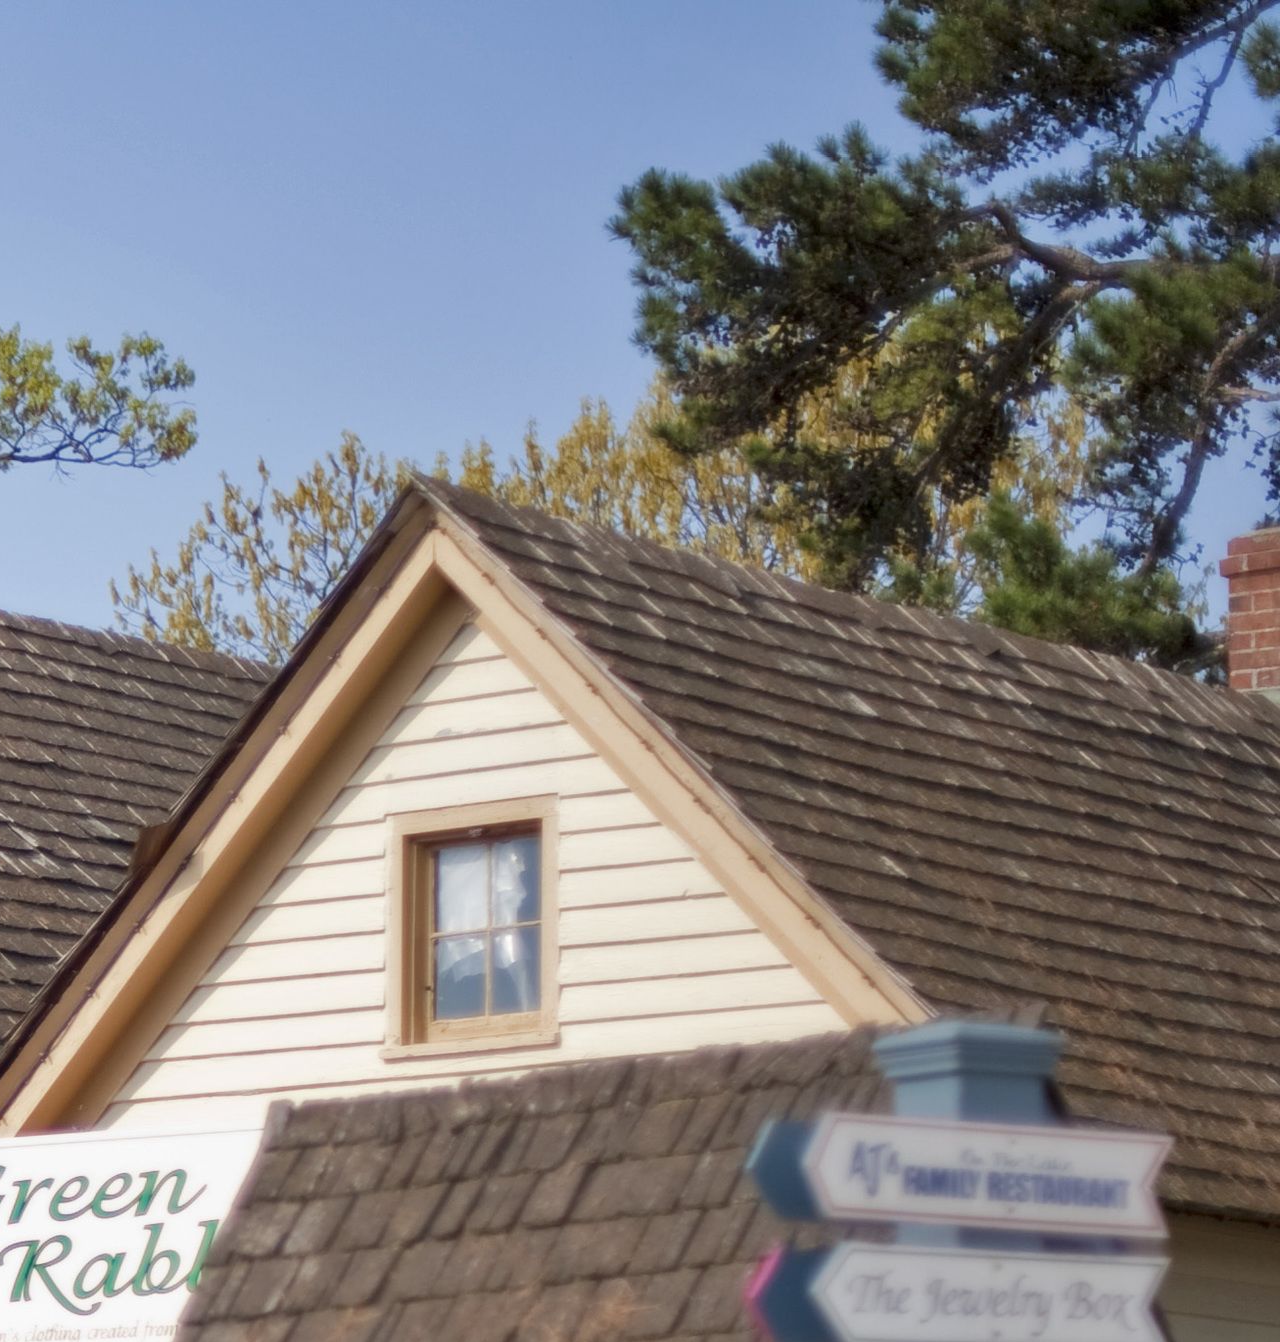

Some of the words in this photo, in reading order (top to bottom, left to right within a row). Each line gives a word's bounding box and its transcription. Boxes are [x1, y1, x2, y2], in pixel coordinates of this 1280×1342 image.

[904, 1165, 980, 1199] FAMILY
[987, 1170, 1131, 1208] RESTAURANT
[847, 1270, 914, 1316] The
[920, 1273, 1053, 1336] Jewelry
[1064, 1281, 1138, 1332] Box
[88, 1323, 138, 1341] created
